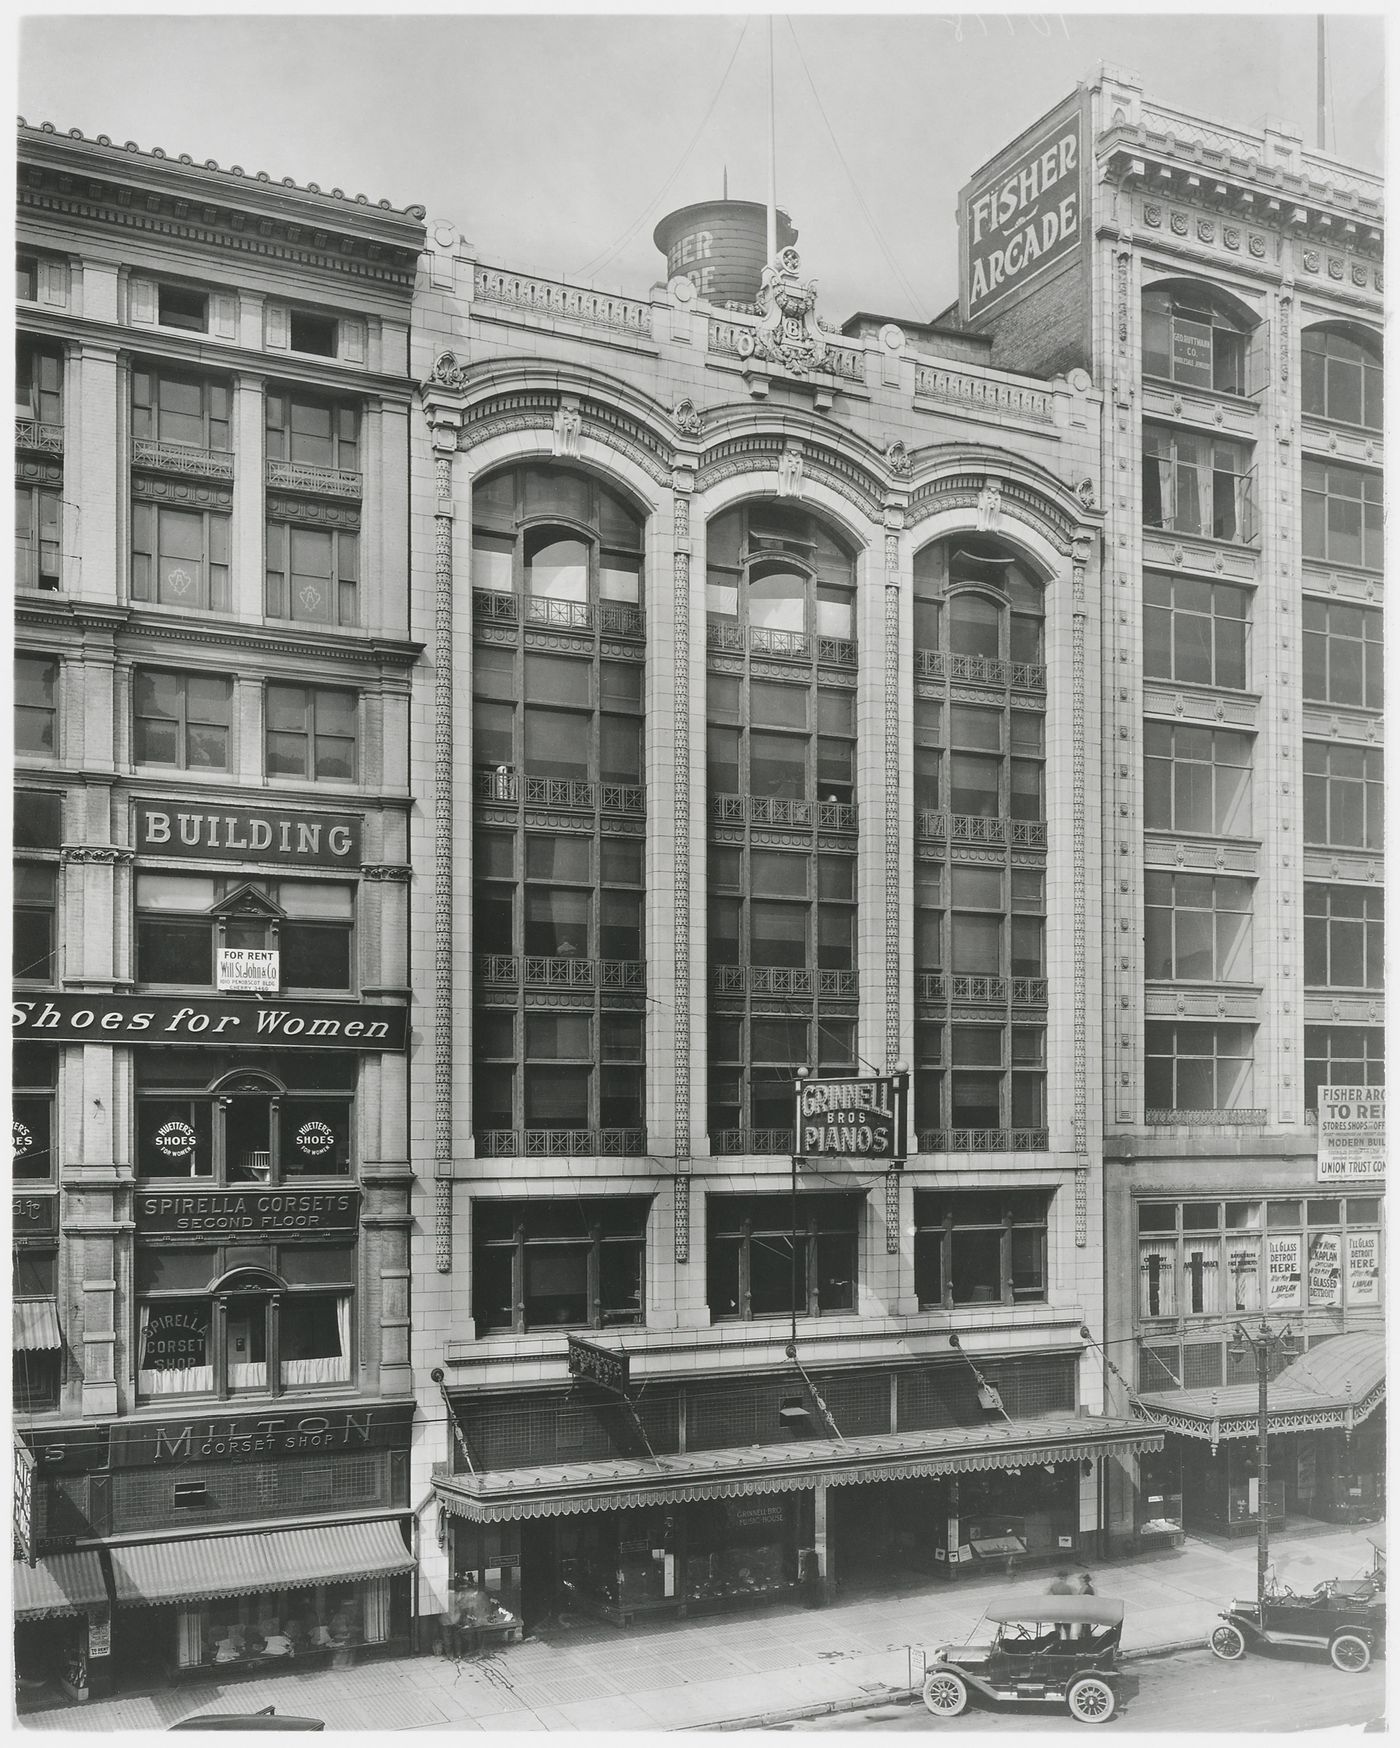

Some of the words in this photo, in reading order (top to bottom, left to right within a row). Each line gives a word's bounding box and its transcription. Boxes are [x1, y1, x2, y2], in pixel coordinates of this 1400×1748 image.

[973, 134, 1076, 245] FISHER
[970, 192, 1076, 305] ARCADE
[145, 811, 352, 856] BUILDING
[224, 951, 243, 960] FOR
[248, 952, 273, 961] RENT
[12, 1001, 154, 1032] Shoes
[165, 1008, 240, 1033] for
[256, 1010, 391, 1038] Women
[802, 1083, 893, 1119] GRINNELL
[1323, 1088, 1362, 1101] FISHER
[827, 1112, 866, 1123] BROS
[1327, 1104, 1351, 1119] TO
[158, 1122, 194, 1136] HUETTER'S
[1322, 1121, 1347, 1131] STORES
[1348, 1121, 1368, 1131] SHOPS
[155, 1136, 196, 1146] SHOES
[296, 1135, 334, 1145] SHOES
[804, 1126, 889, 1153] PIANOS
[1328, 1138, 1364, 1147] MODERN
[160, 1146, 172, 1156] FOR
[173, 1146, 192, 1157] WOMEN
[311, 1145, 330, 1156] WOMEN
[1321, 1162, 1346, 1174] UNION
[1349, 1161, 1372, 1174] TRUST
[144, 1197, 247, 1215] SPIRELLA
[257, 1196, 350, 1212] CORSETS
[177, 1217, 253, 1229] SECOND
[261, 1215, 320, 1228] FLOOR
[1280, 1241, 1297, 1252] GLASS
[1359, 1238, 1375, 1248] GLASS
[1270, 1253, 1297, 1262] DETROIT
[1351, 1249, 1373, 1258] DETROIT
[1270, 1263, 1297, 1273] HERE
[1350, 1259, 1375, 1268] HERE
[142, 1314, 208, 1338] SPIRELLA
[147, 1339, 204, 1354] CORSET
[155, 1357, 196, 1371] SHOP
[155, 1413, 373, 1459] MILTON
[201, 1439, 276, 1455] CORSET
[285, 1434, 334, 1449] SHOP
